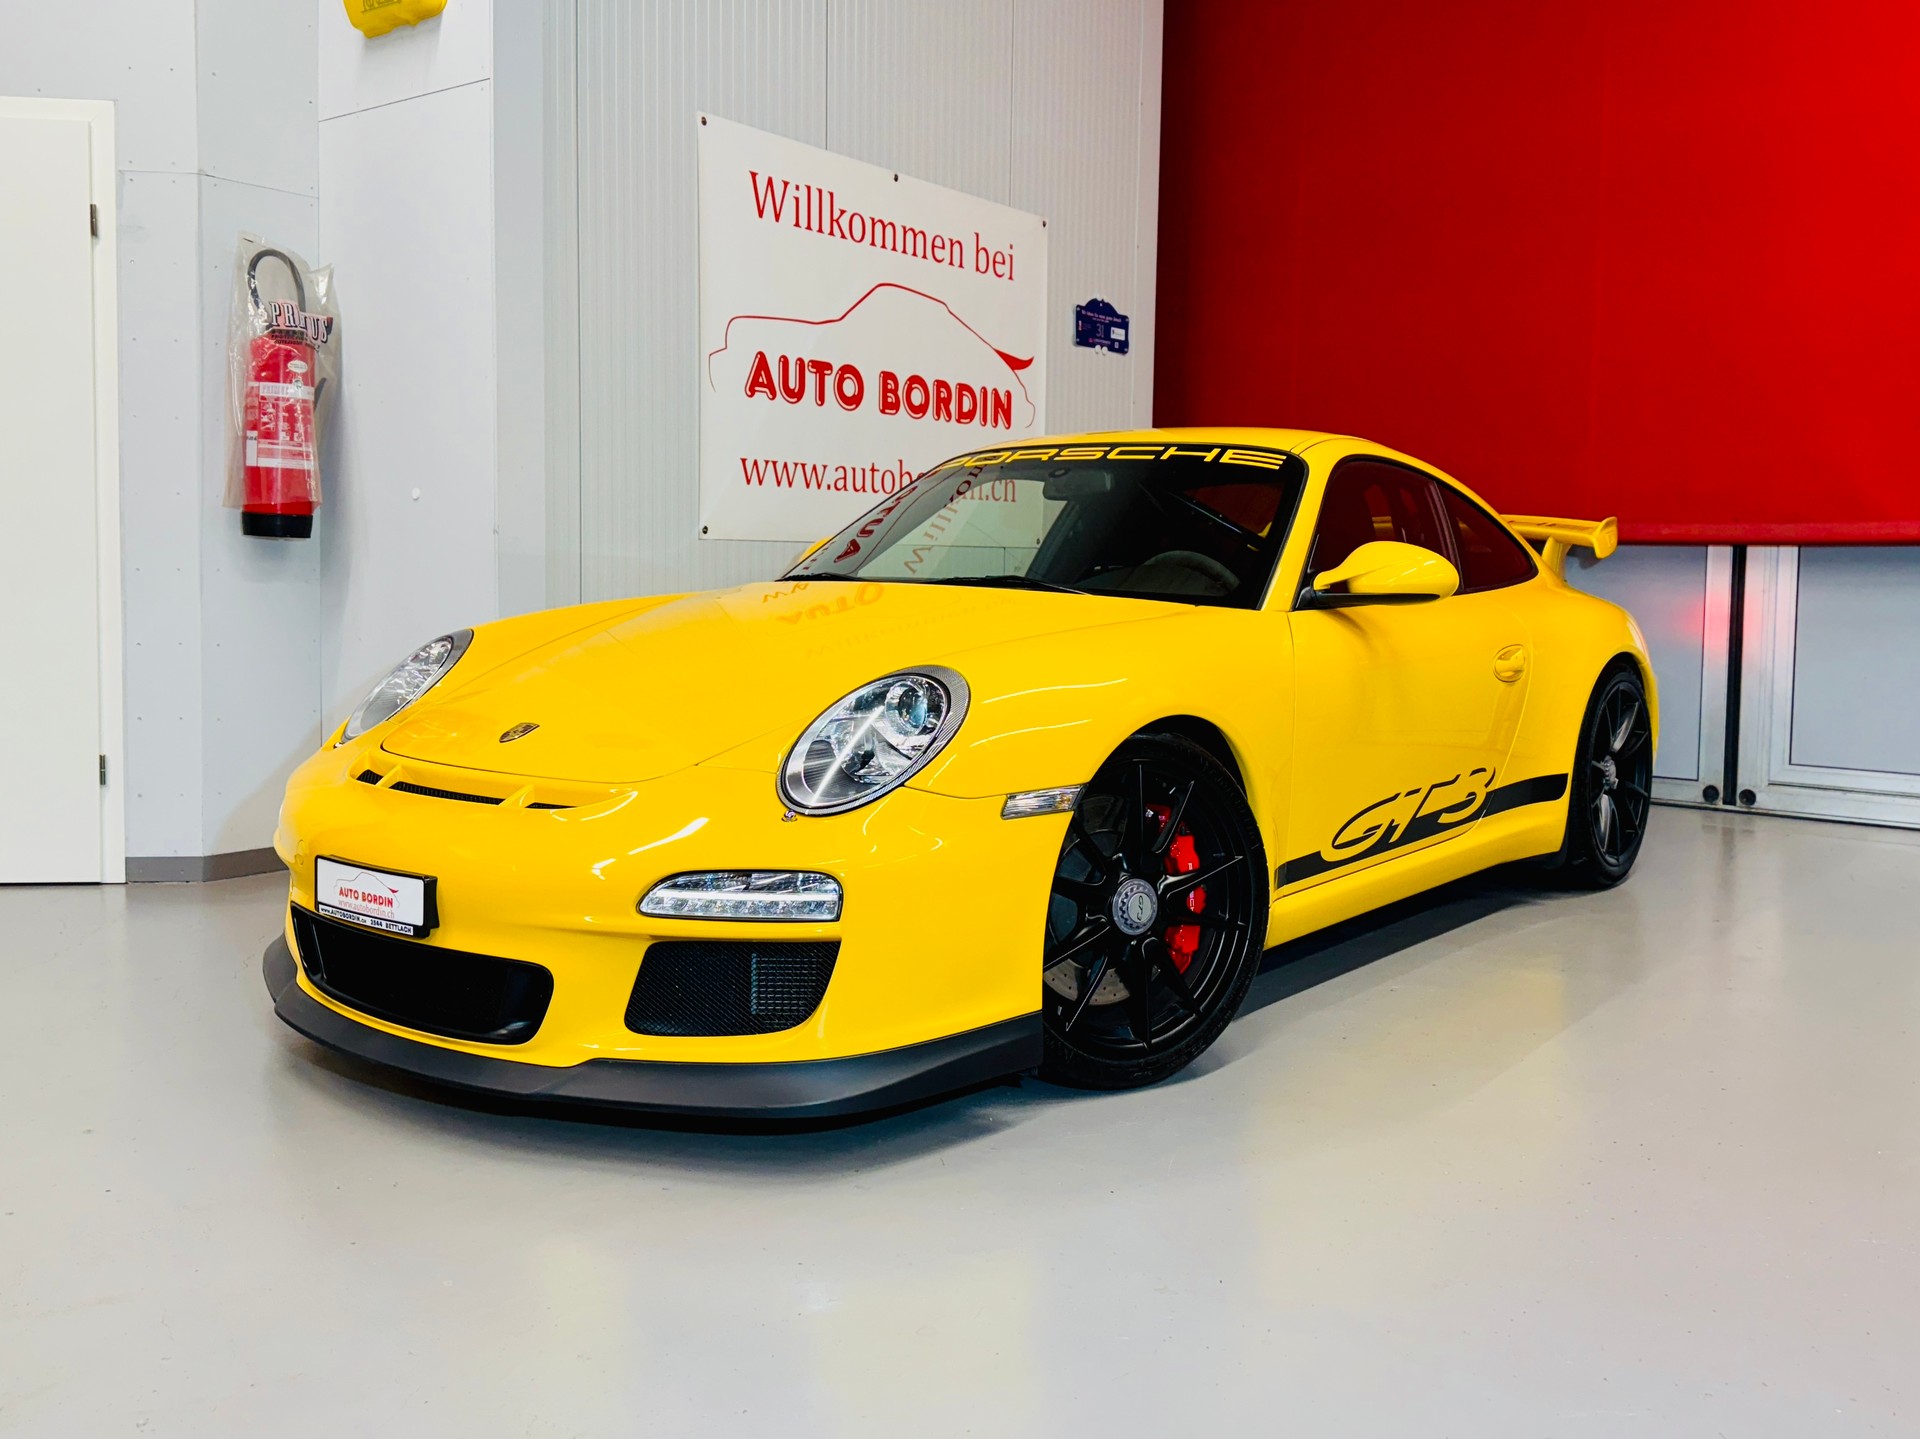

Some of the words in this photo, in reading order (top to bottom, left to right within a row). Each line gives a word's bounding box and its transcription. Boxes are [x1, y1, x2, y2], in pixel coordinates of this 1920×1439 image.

[748, 170, 965, 269] Willkommen
[974, 232, 1015, 281] bei
[745, 351, 864, 411] AUTO
[879, 371, 1012, 430] BORDIN
[1320, 766, 1496, 862] GT3
[339, 887, 359, 899] AUTO
[362, 892, 393, 907] BORDIN
